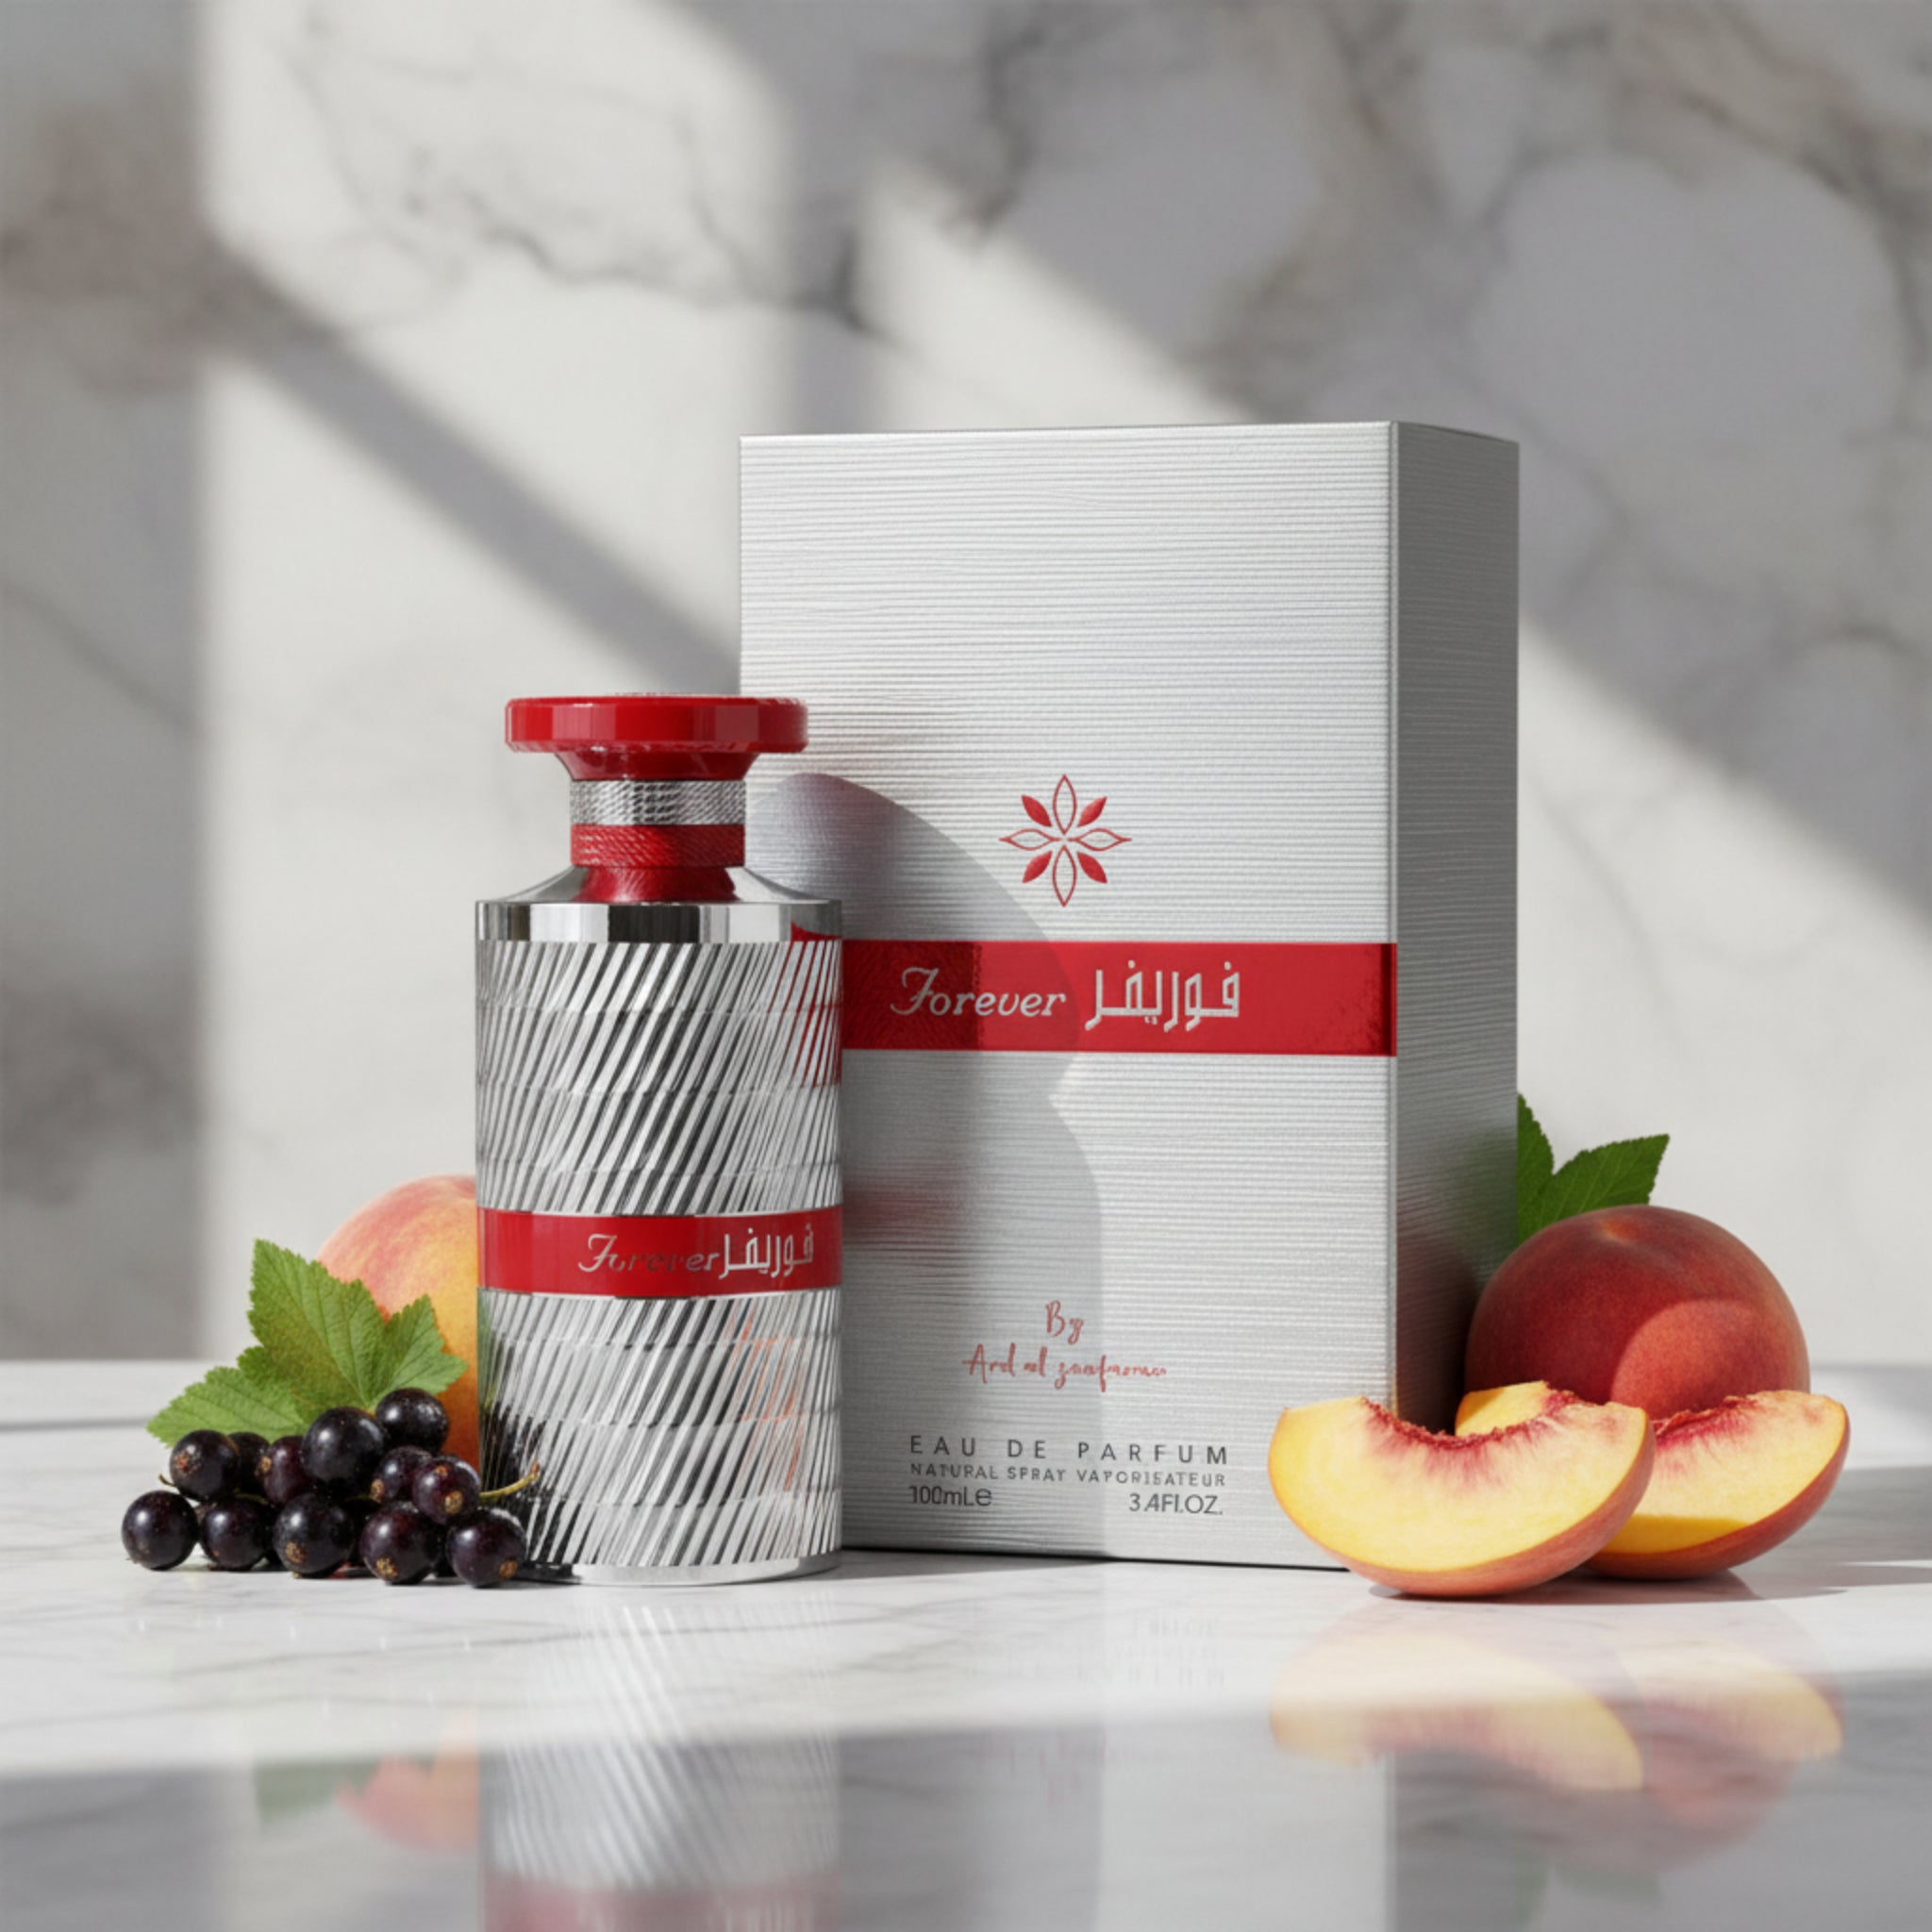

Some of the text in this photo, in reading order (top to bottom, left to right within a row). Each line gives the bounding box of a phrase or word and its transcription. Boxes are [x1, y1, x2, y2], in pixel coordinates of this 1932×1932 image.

[890, 967, 1066, 1016] Forever
[1085, 960, 1240, 1032] فوريفر
[1045, 1300, 1084, 1344] By
[910, 1435, 1227, 1464] EAU DE PARFUM
[910, 1463, 998, 1480] NATURAL
